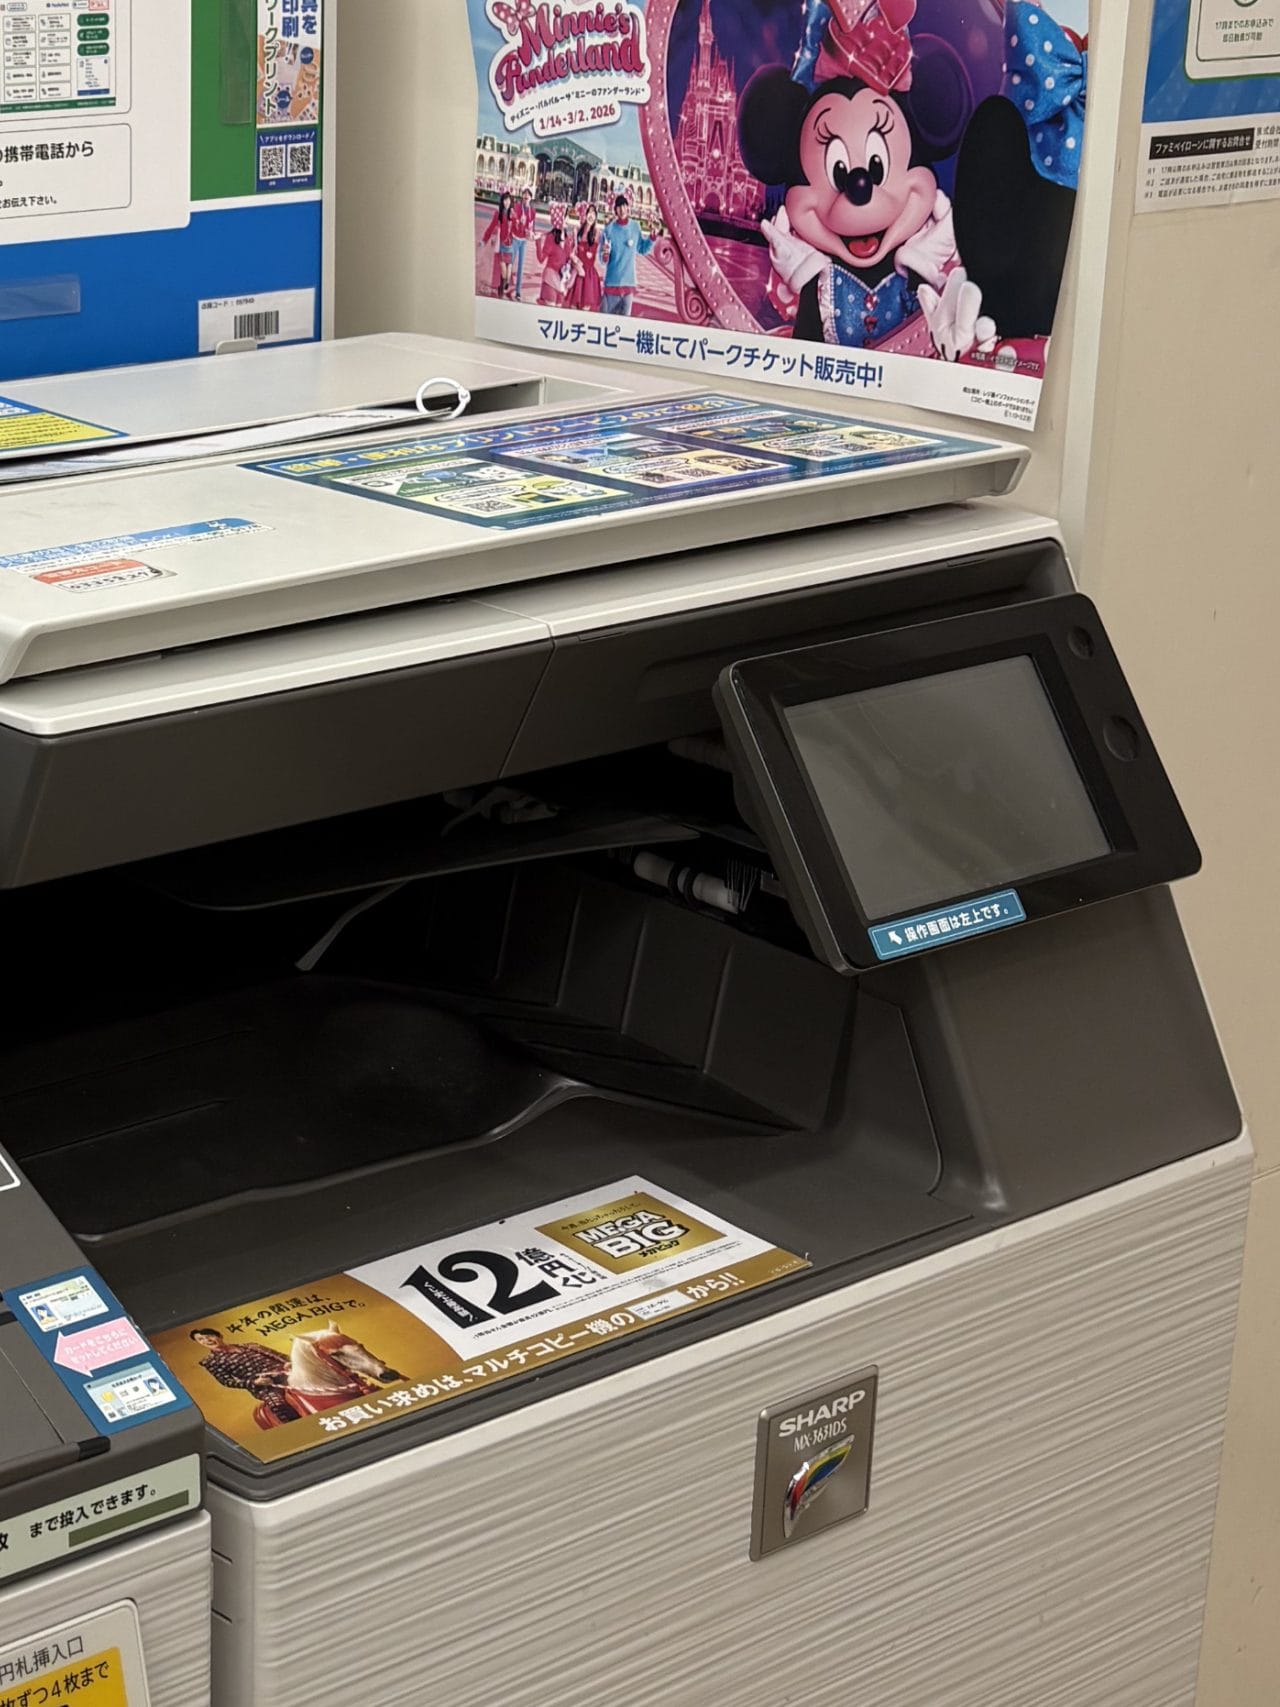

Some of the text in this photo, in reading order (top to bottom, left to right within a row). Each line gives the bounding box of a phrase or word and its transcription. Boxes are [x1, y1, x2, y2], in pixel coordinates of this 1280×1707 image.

[590, 103, 616, 120] 2026
[537, 317, 884, 389] マルチコピー機にてパークチケット販売中!
[904, 903, 1010, 942] 操作画面は左上です。
[573, 1209, 666, 1244] MEGA
[592, 1219, 690, 1259] BIG
[255, 1309, 312, 1337] MEGA
[319, 1311, 635, 1433] お買い求めは、マルチコピー機の
[778, 1390, 865, 1438] SHARP
[793, 1417, 847, 1452] MX-3631DS
[29, 1484, 157, 1539] まで投入できます。
